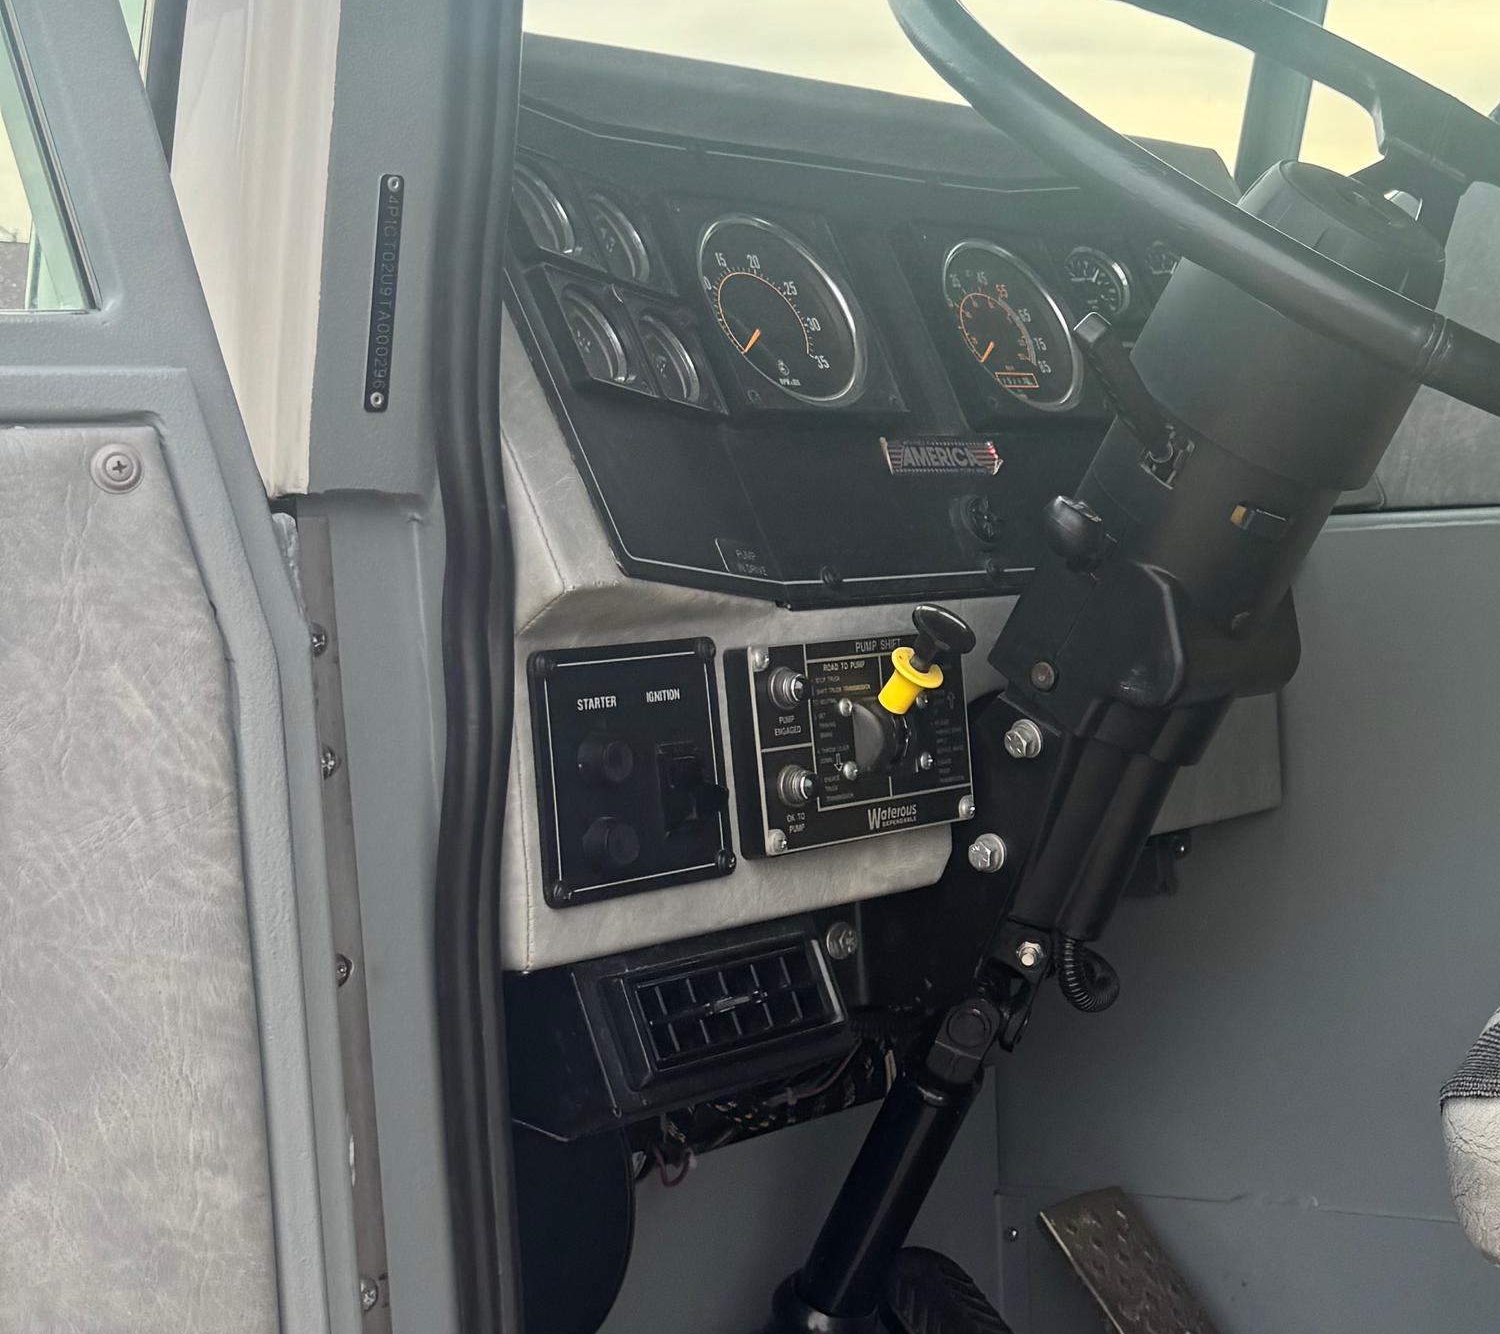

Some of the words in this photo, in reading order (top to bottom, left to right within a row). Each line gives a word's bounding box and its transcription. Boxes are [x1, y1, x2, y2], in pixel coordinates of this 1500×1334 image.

[715, 252, 727, 267] 15
[747, 254, 761, 269] 20
[784, 281, 798, 295] 25
[995, 283, 1009, 299] 55
[1018, 308, 1032, 323] 65
[808, 317, 821, 332] 30
[1033, 337, 1047, 351] 75
[814, 355, 830, 369] 35
[901, 445, 980, 468] AMERICA
[855, 641, 876, 652] PUMP
[880, 639, 901, 649] SHIFT
[823, 663, 839, 672] ROAD
[841, 662, 849, 670] TO
[850, 661, 865, 669] PUMP
[576, 694, 617, 712] STARTER
[645, 686, 681, 704] IGNITION
[779, 715, 795, 723] PUMP
[774, 726, 802, 736] ENGAGED
[786, 814, 796, 822] OK
[797, 812, 805, 821] TO
[867, 804, 917, 830] Waterous
[789, 824, 805, 833] PUMP
